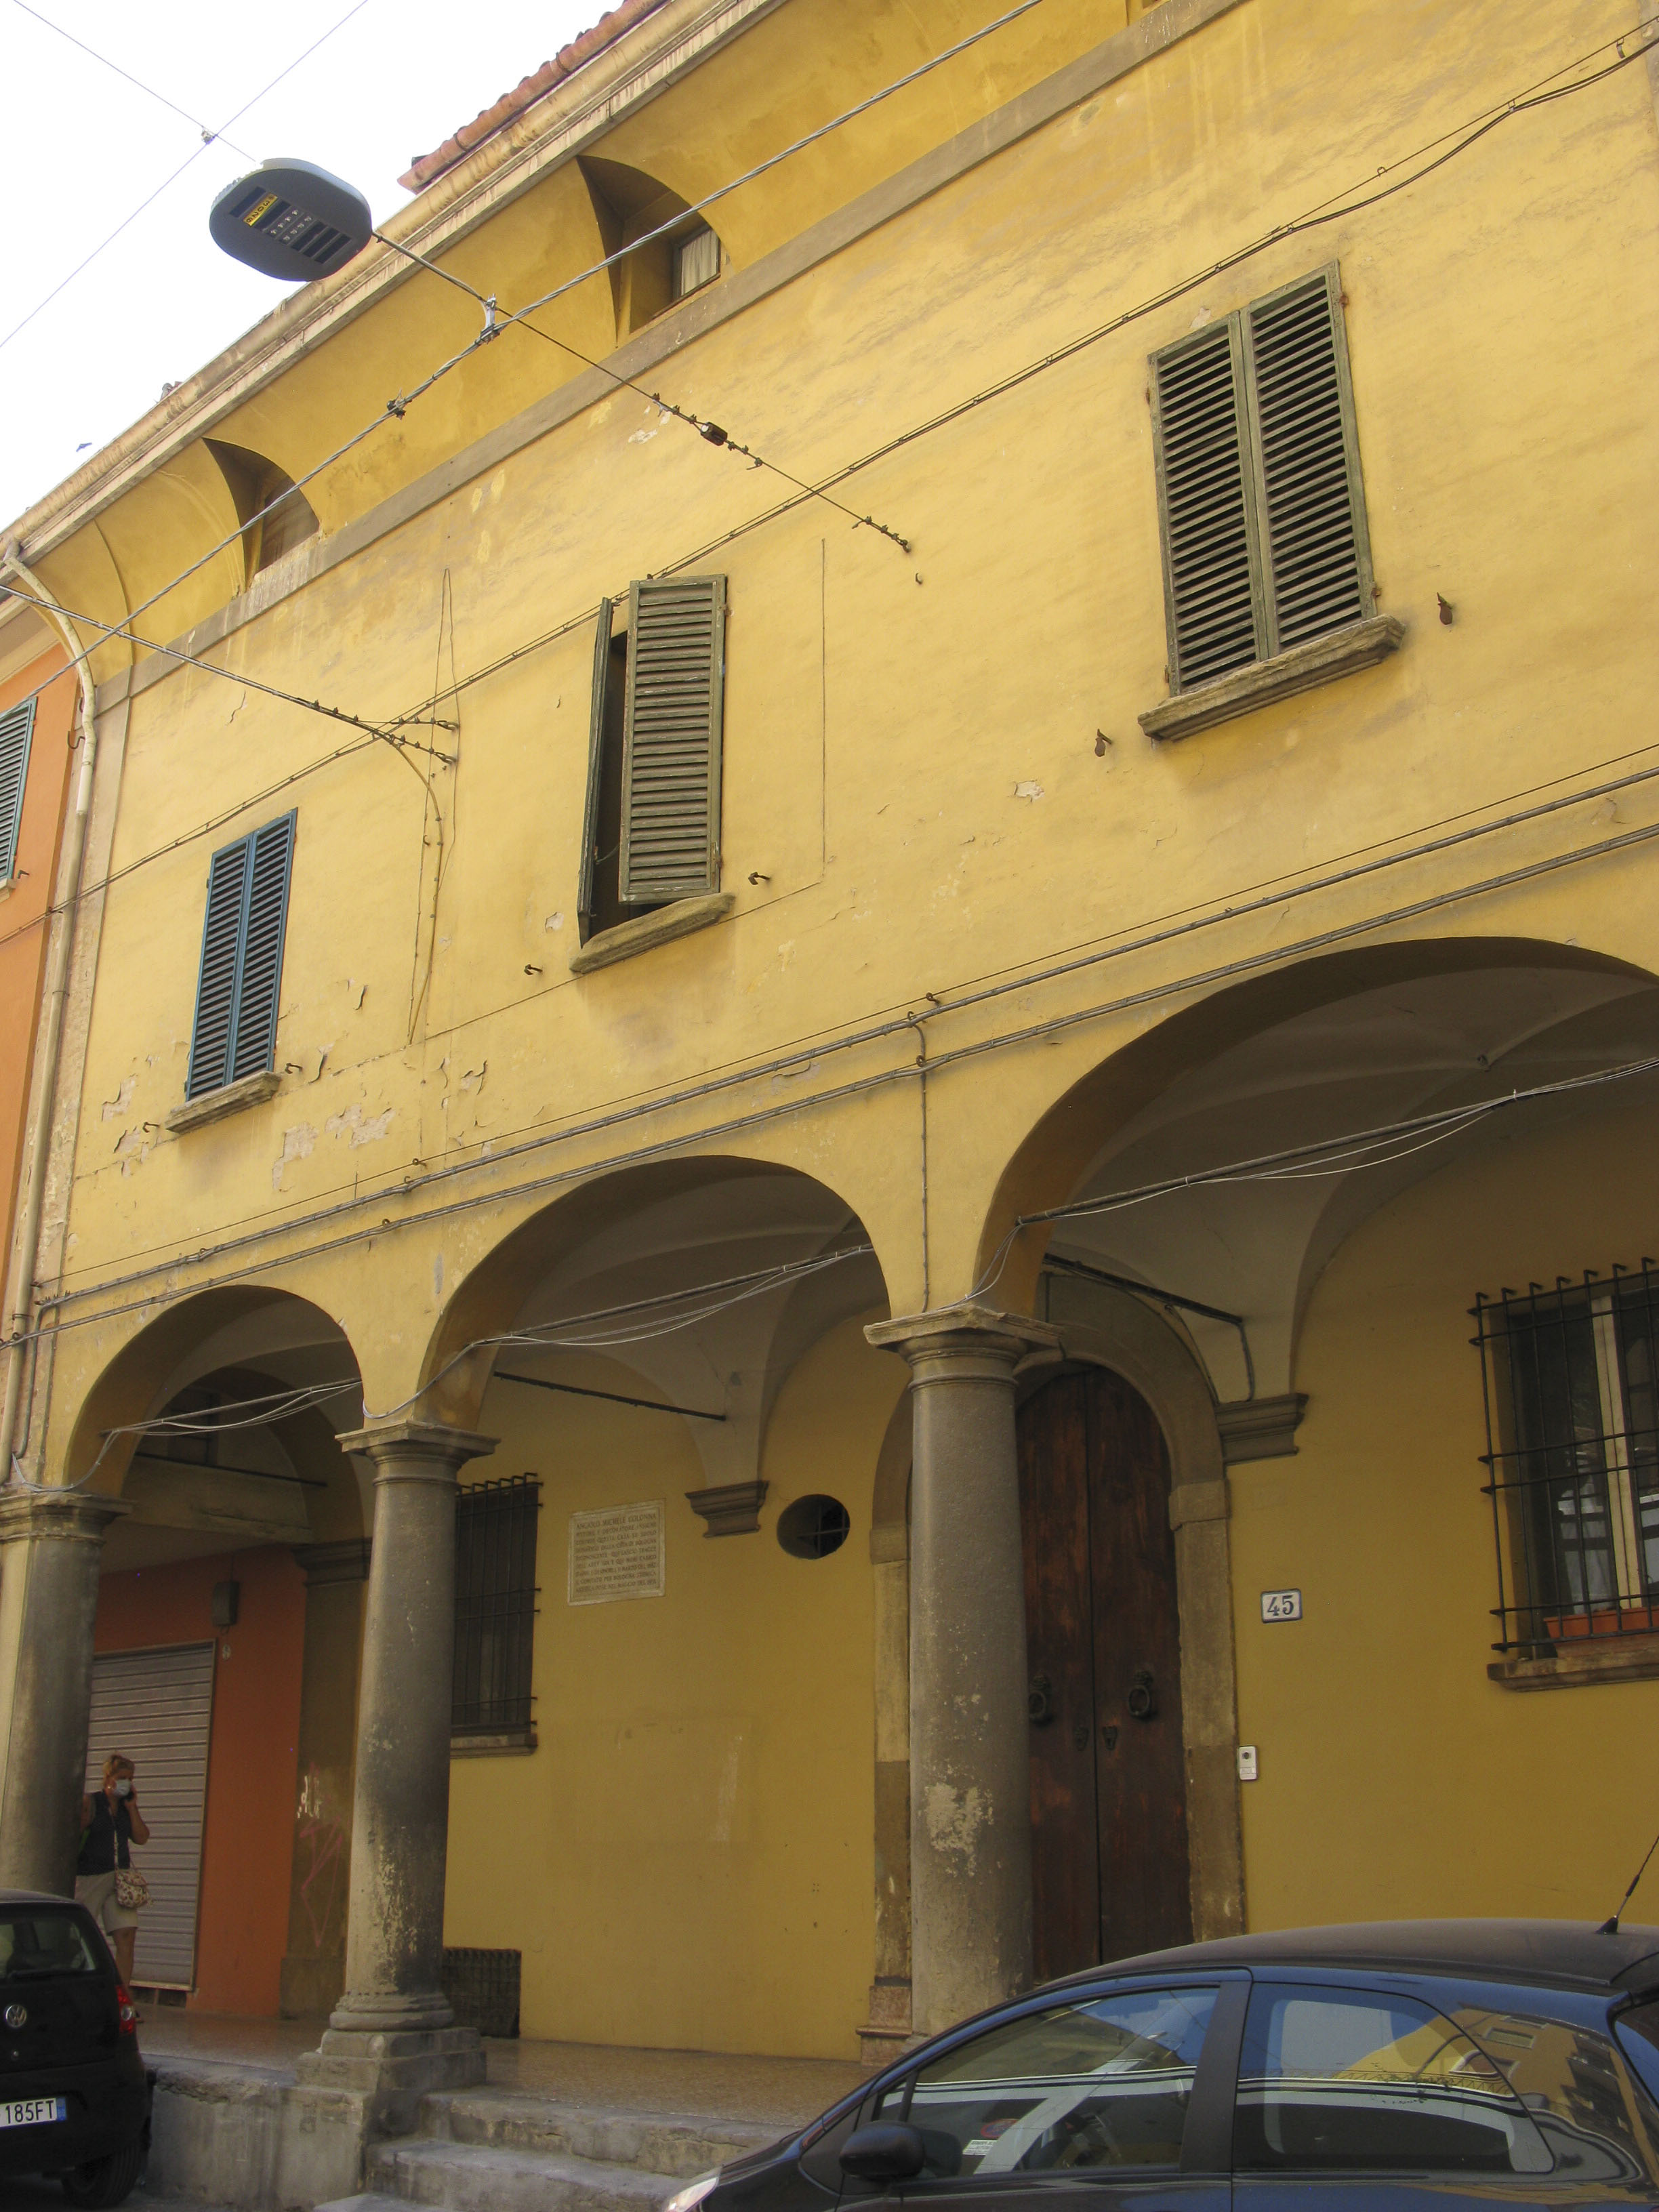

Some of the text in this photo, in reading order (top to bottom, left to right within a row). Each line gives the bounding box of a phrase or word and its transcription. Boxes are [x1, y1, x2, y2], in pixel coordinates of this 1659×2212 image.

[246, 200, 271, 224] 3026
[1267, 1595, 1294, 1616] 45
[5, 2100, 55, 2124] 185FT
